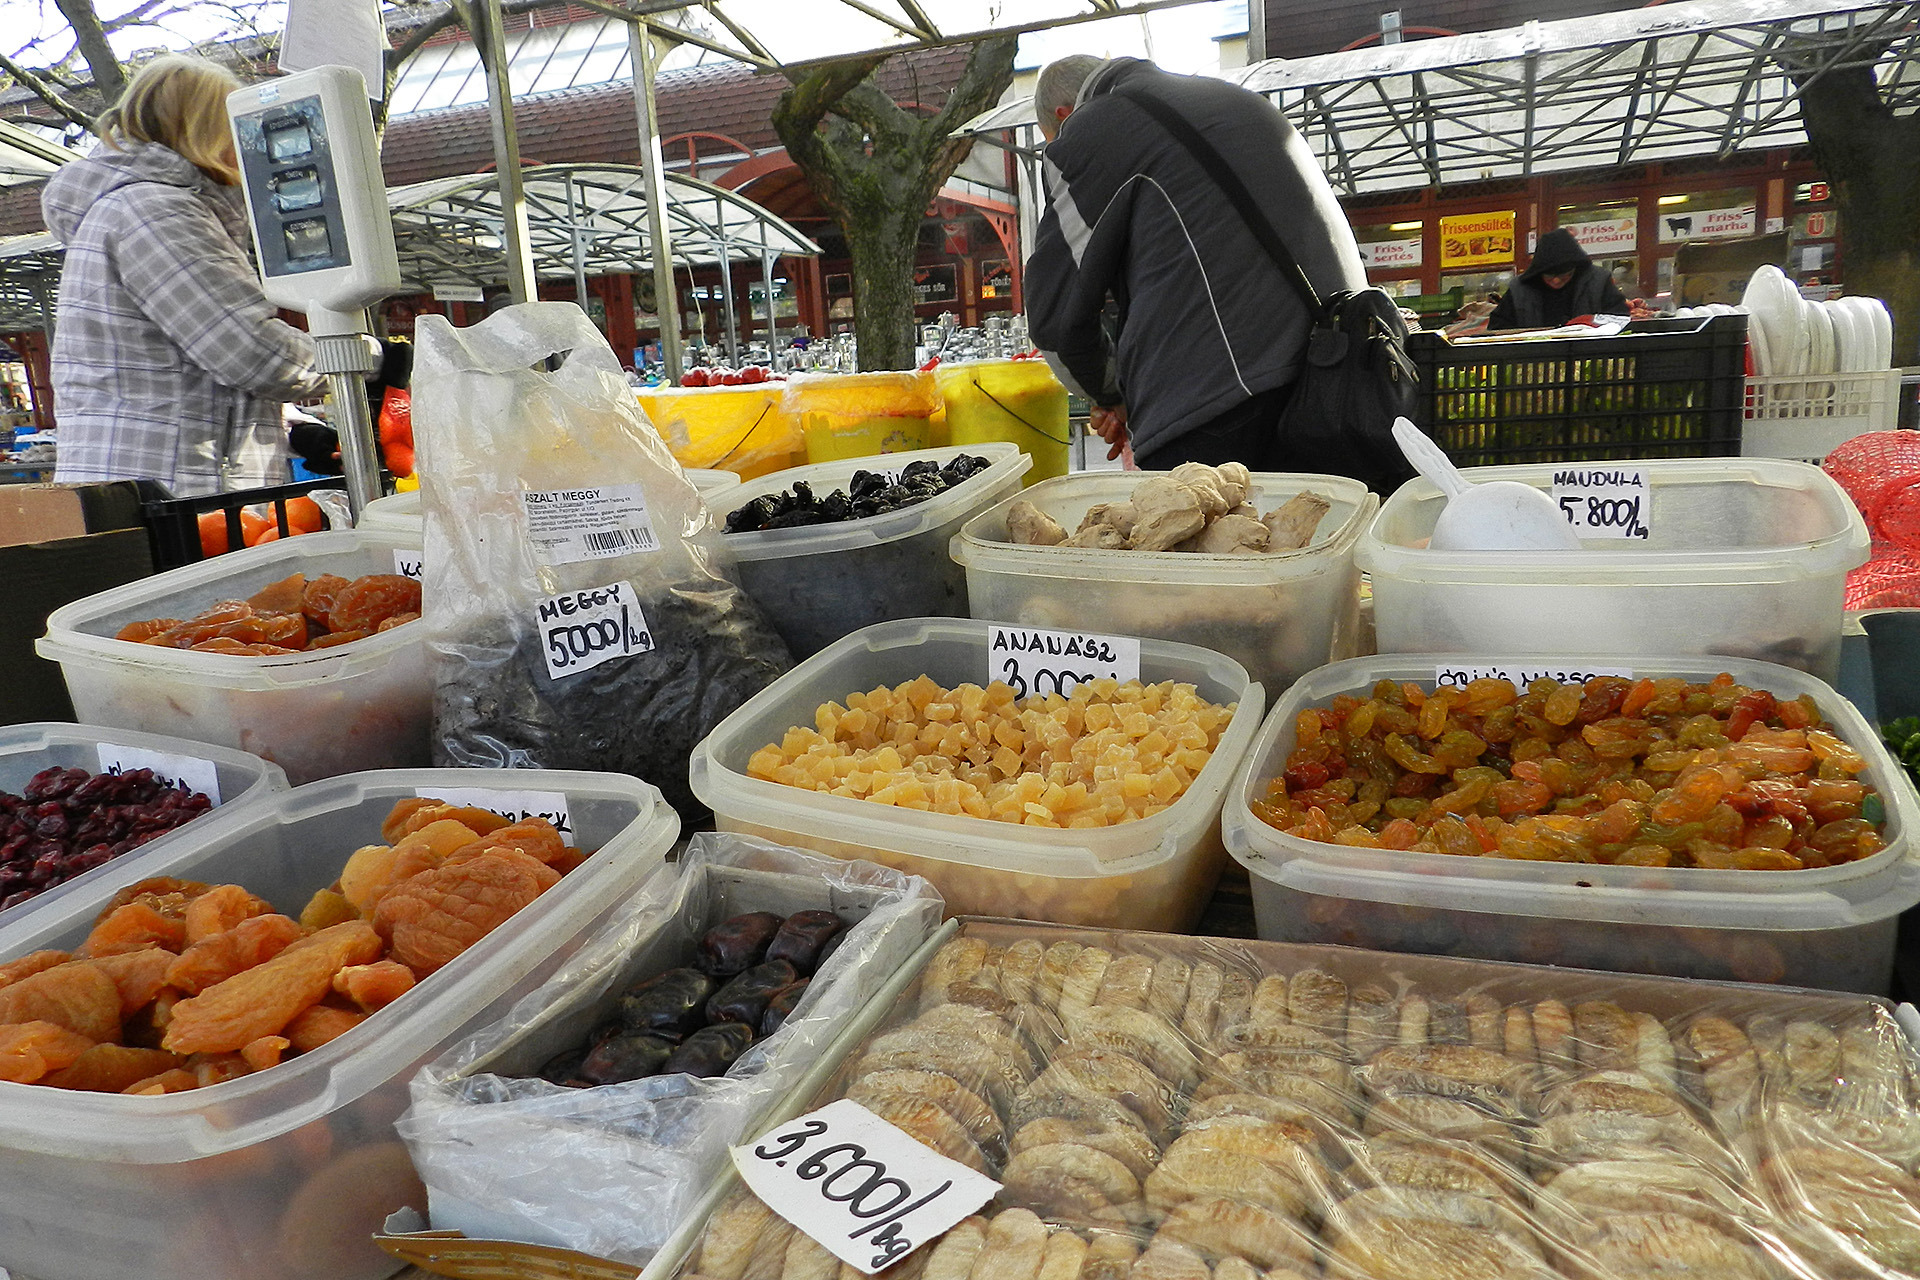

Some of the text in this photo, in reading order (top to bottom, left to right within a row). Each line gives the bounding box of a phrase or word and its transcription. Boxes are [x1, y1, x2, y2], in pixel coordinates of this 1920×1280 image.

[1708, 213, 1743, 222] Friss
[1442, 218, 1512, 236] Frissensültek
[1582, 225, 1615, 235] Friss
[1701, 223, 1748, 233] marha
[1375, 246, 1404, 254] Friss
[1374, 253, 1413, 263] sertés
[525, 490, 600, 503] ASZALT MEGGY
[540, 584, 620, 623] MEGGY
[754, 1120, 953, 1268] 3.600/kg
